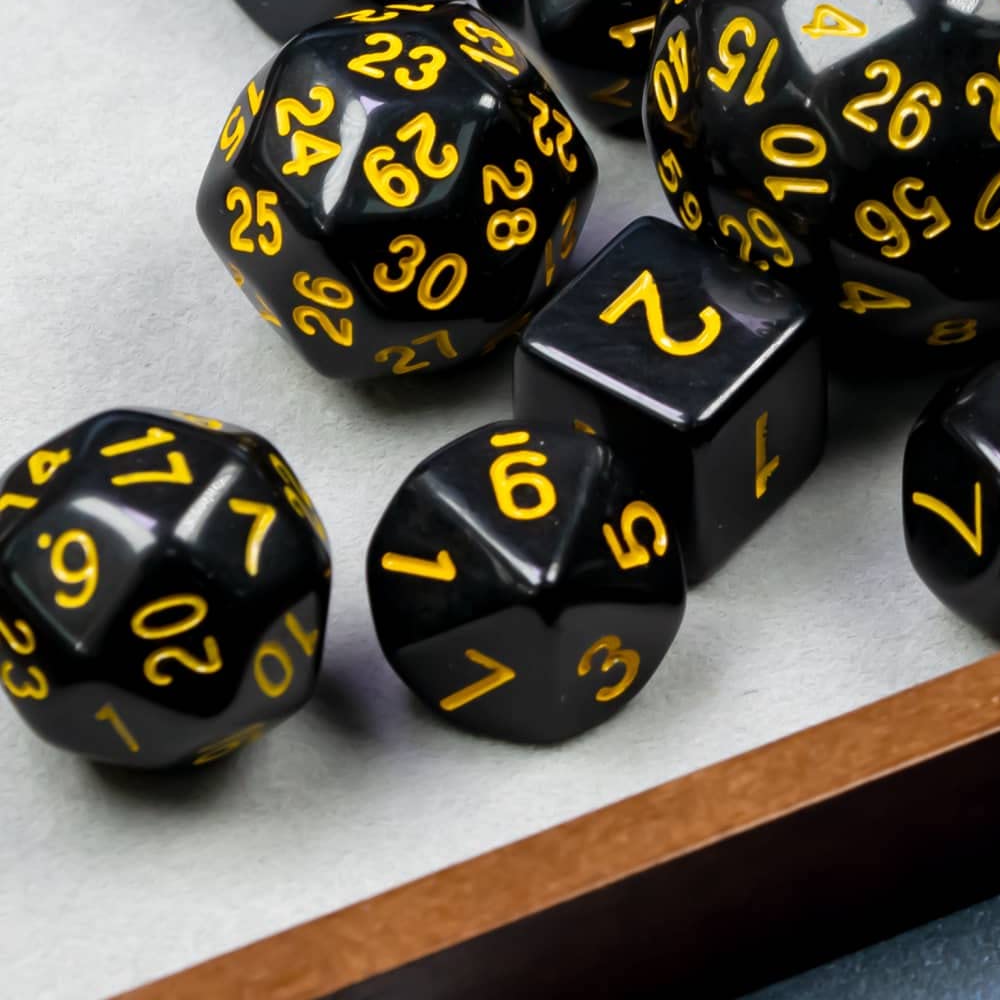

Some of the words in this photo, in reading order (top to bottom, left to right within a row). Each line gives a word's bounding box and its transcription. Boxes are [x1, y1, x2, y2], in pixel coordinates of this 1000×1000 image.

[347, 31, 447, 92] 23
[452, 17, 521, 77] 13
[654, 30, 688, 121] 40
[706, 15, 781, 106] 15
[220, 81, 264, 162] 15
[273, 85, 342, 178] 24
[528, 93, 578, 173] 22
[842, 59, 942, 151] 26
[760, 124, 829, 201] 10
[225, 184, 284, 258] 25
[482, 159, 537, 251] 28
[292, 270, 355, 347] 26
[373, 234, 468, 311] 30
[598, 269, 723, 357] 2
[373, 329, 460, 375] 27
[99, 426, 194, 487] 17
[228, 497, 278, 577] 7
[602, 500, 669, 570] 5
[912, 482, 983, 556] 7
[381, 549, 457, 582] 1
[130, 593, 223, 687] 20
[577, 635, 640, 702] 3
[440, 648, 516, 711] 7
